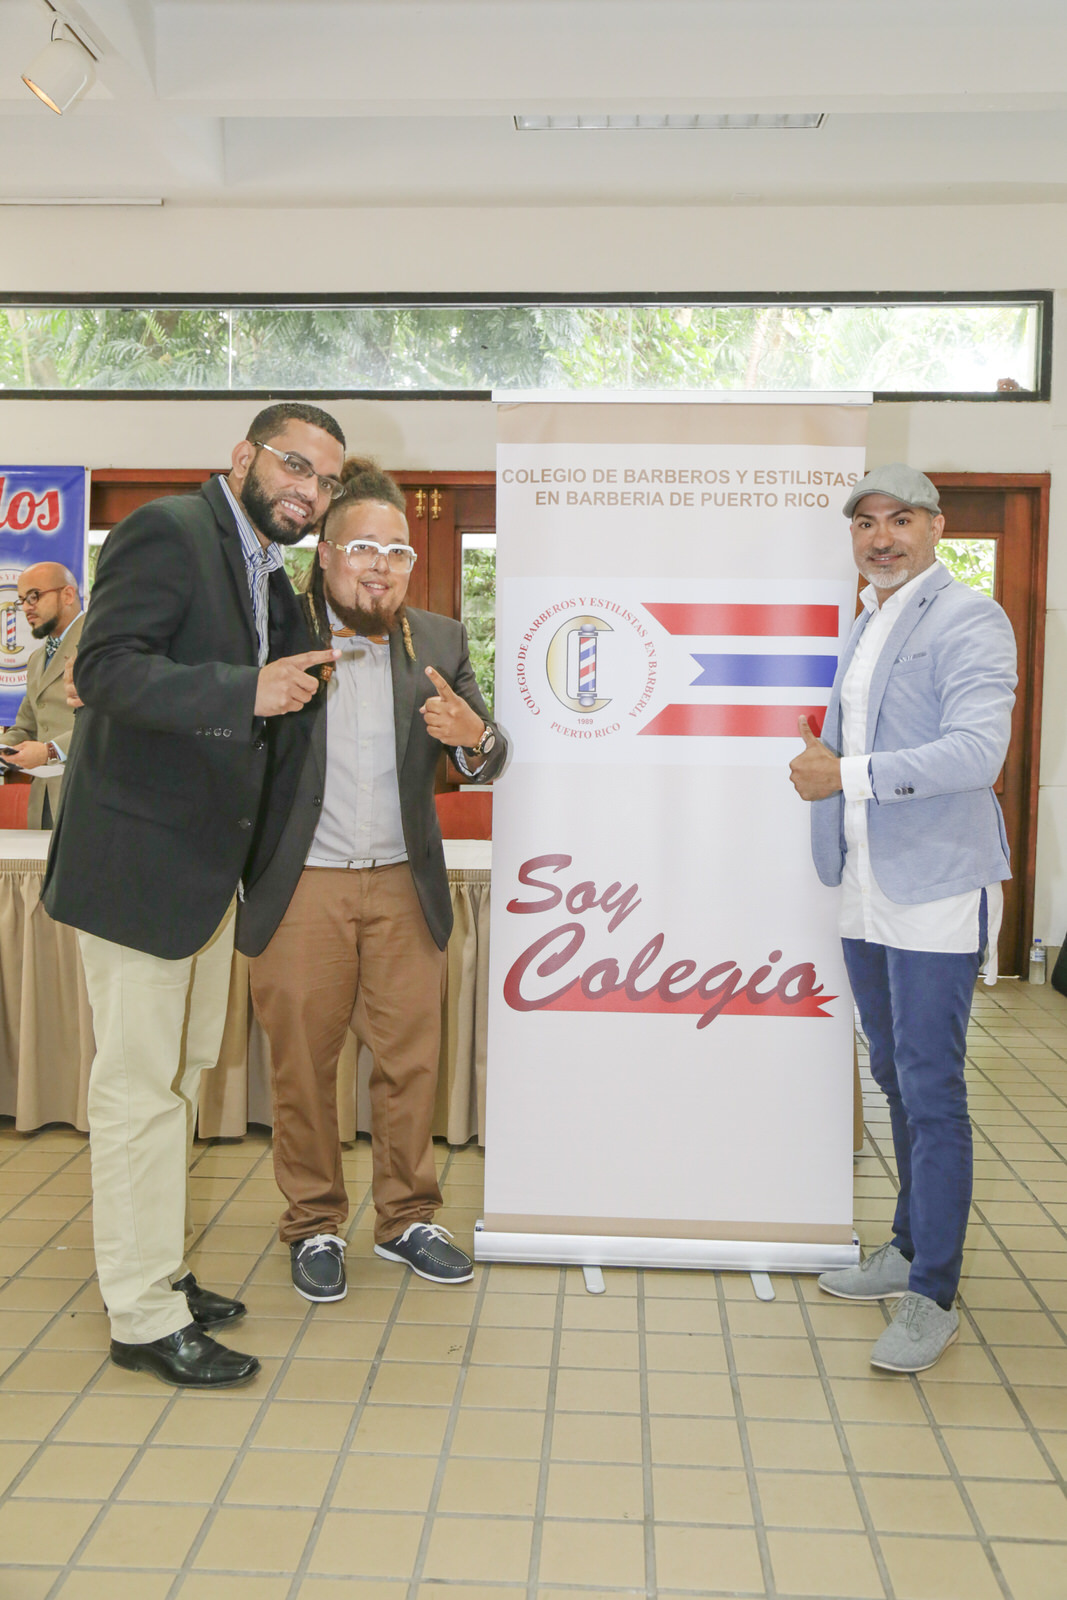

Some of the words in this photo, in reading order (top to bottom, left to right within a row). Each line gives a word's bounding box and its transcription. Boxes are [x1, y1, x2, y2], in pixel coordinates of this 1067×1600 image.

[501, 468, 587, 484] COLEGIO
[592, 469, 618, 484] DE
[623, 469, 731, 485] BARBEROS
[736, 470, 749, 485] Y
[753, 469, 859, 488] ESTILISTAS
[535, 491, 560, 506] EN
[566, 491, 665, 506] BARBERIA
[670, 491, 695, 507] DE
[700, 492, 783, 508] PUERTO
[786, 492, 830, 509] RICO
[578, 597, 587, 607] Y
[523, 598, 577, 643] BARBEROS
[589, 597, 649, 639] ESTILISTAS
[517, 643, 529, 660] DE
[644, 641, 657, 658] EN
[516, 662, 541, 716] COLEGIO
[628, 661, 658, 718] BARBERIA
[550, 721, 592, 739] PUERTO
[594, 722, 621, 738] RICO
[506, 853, 642, 934] Soy
[503, 922, 825, 1030] Colegio
